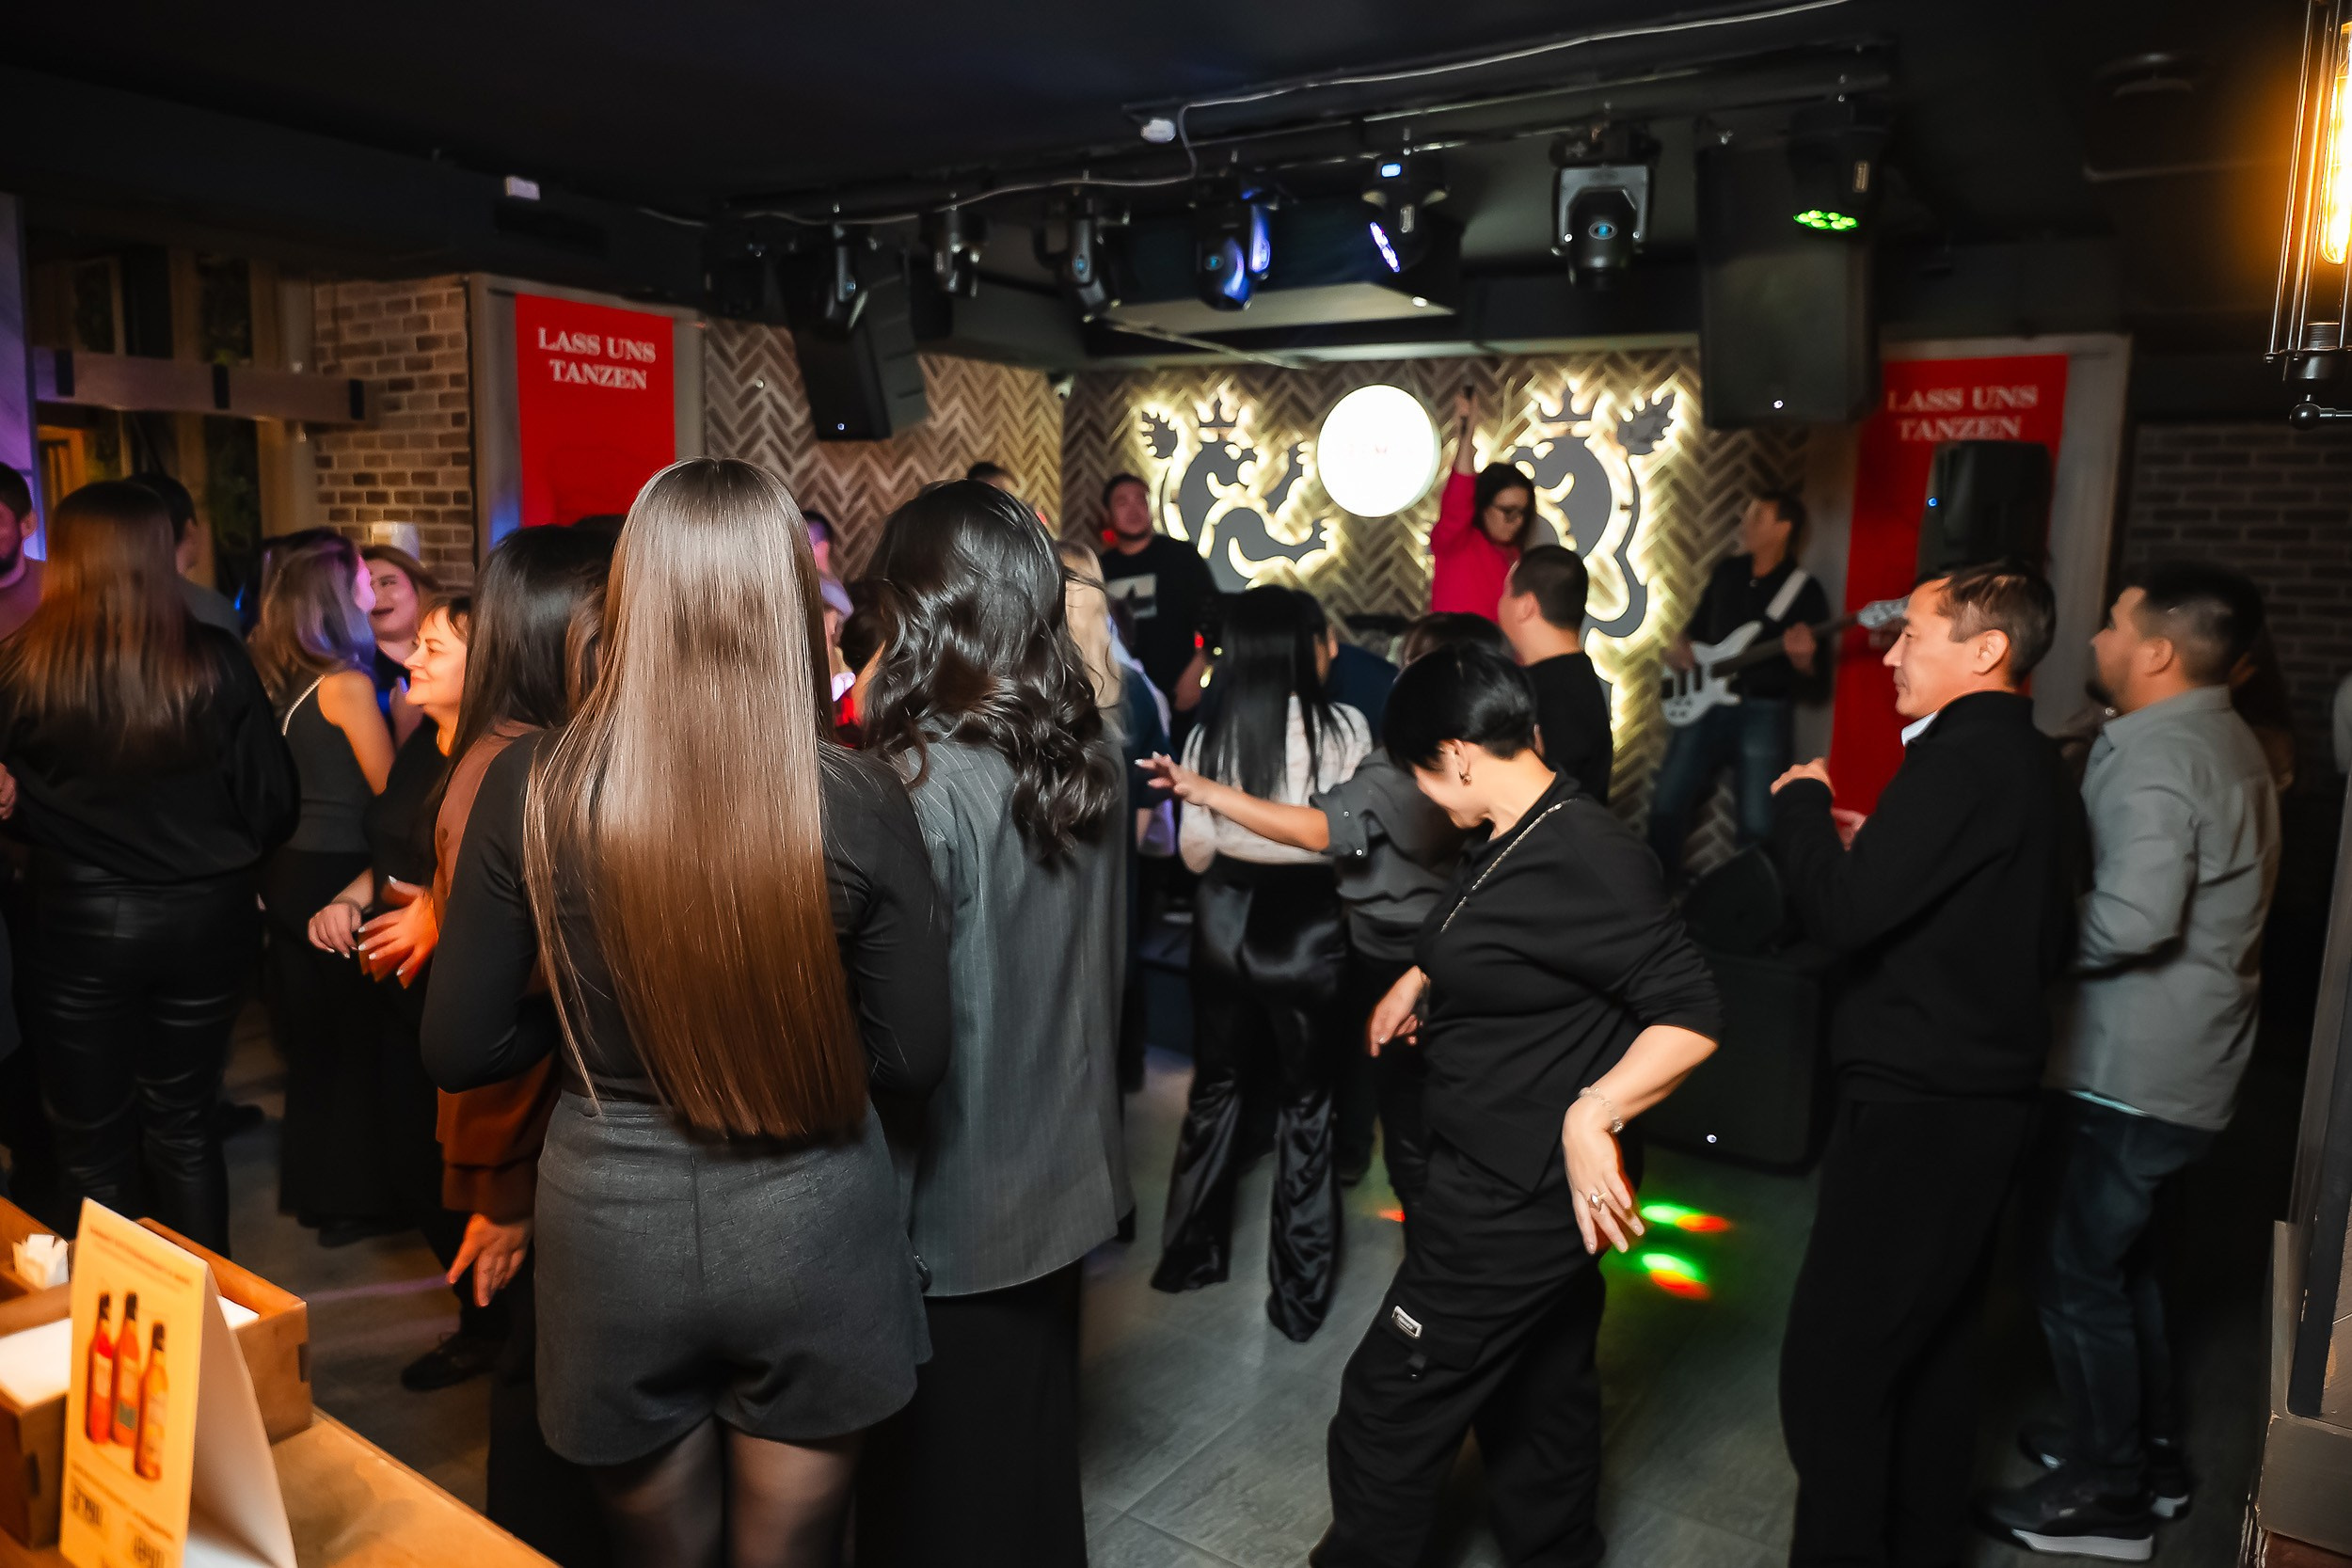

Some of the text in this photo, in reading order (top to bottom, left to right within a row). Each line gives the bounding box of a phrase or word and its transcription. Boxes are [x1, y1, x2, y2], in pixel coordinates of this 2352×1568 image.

[537, 326, 657, 364] LASS UNS
[548, 358, 648, 390] TANZEN
[1887, 384, 2040, 412] LASS UNS
[1898, 415, 2023, 441] TANZEN
